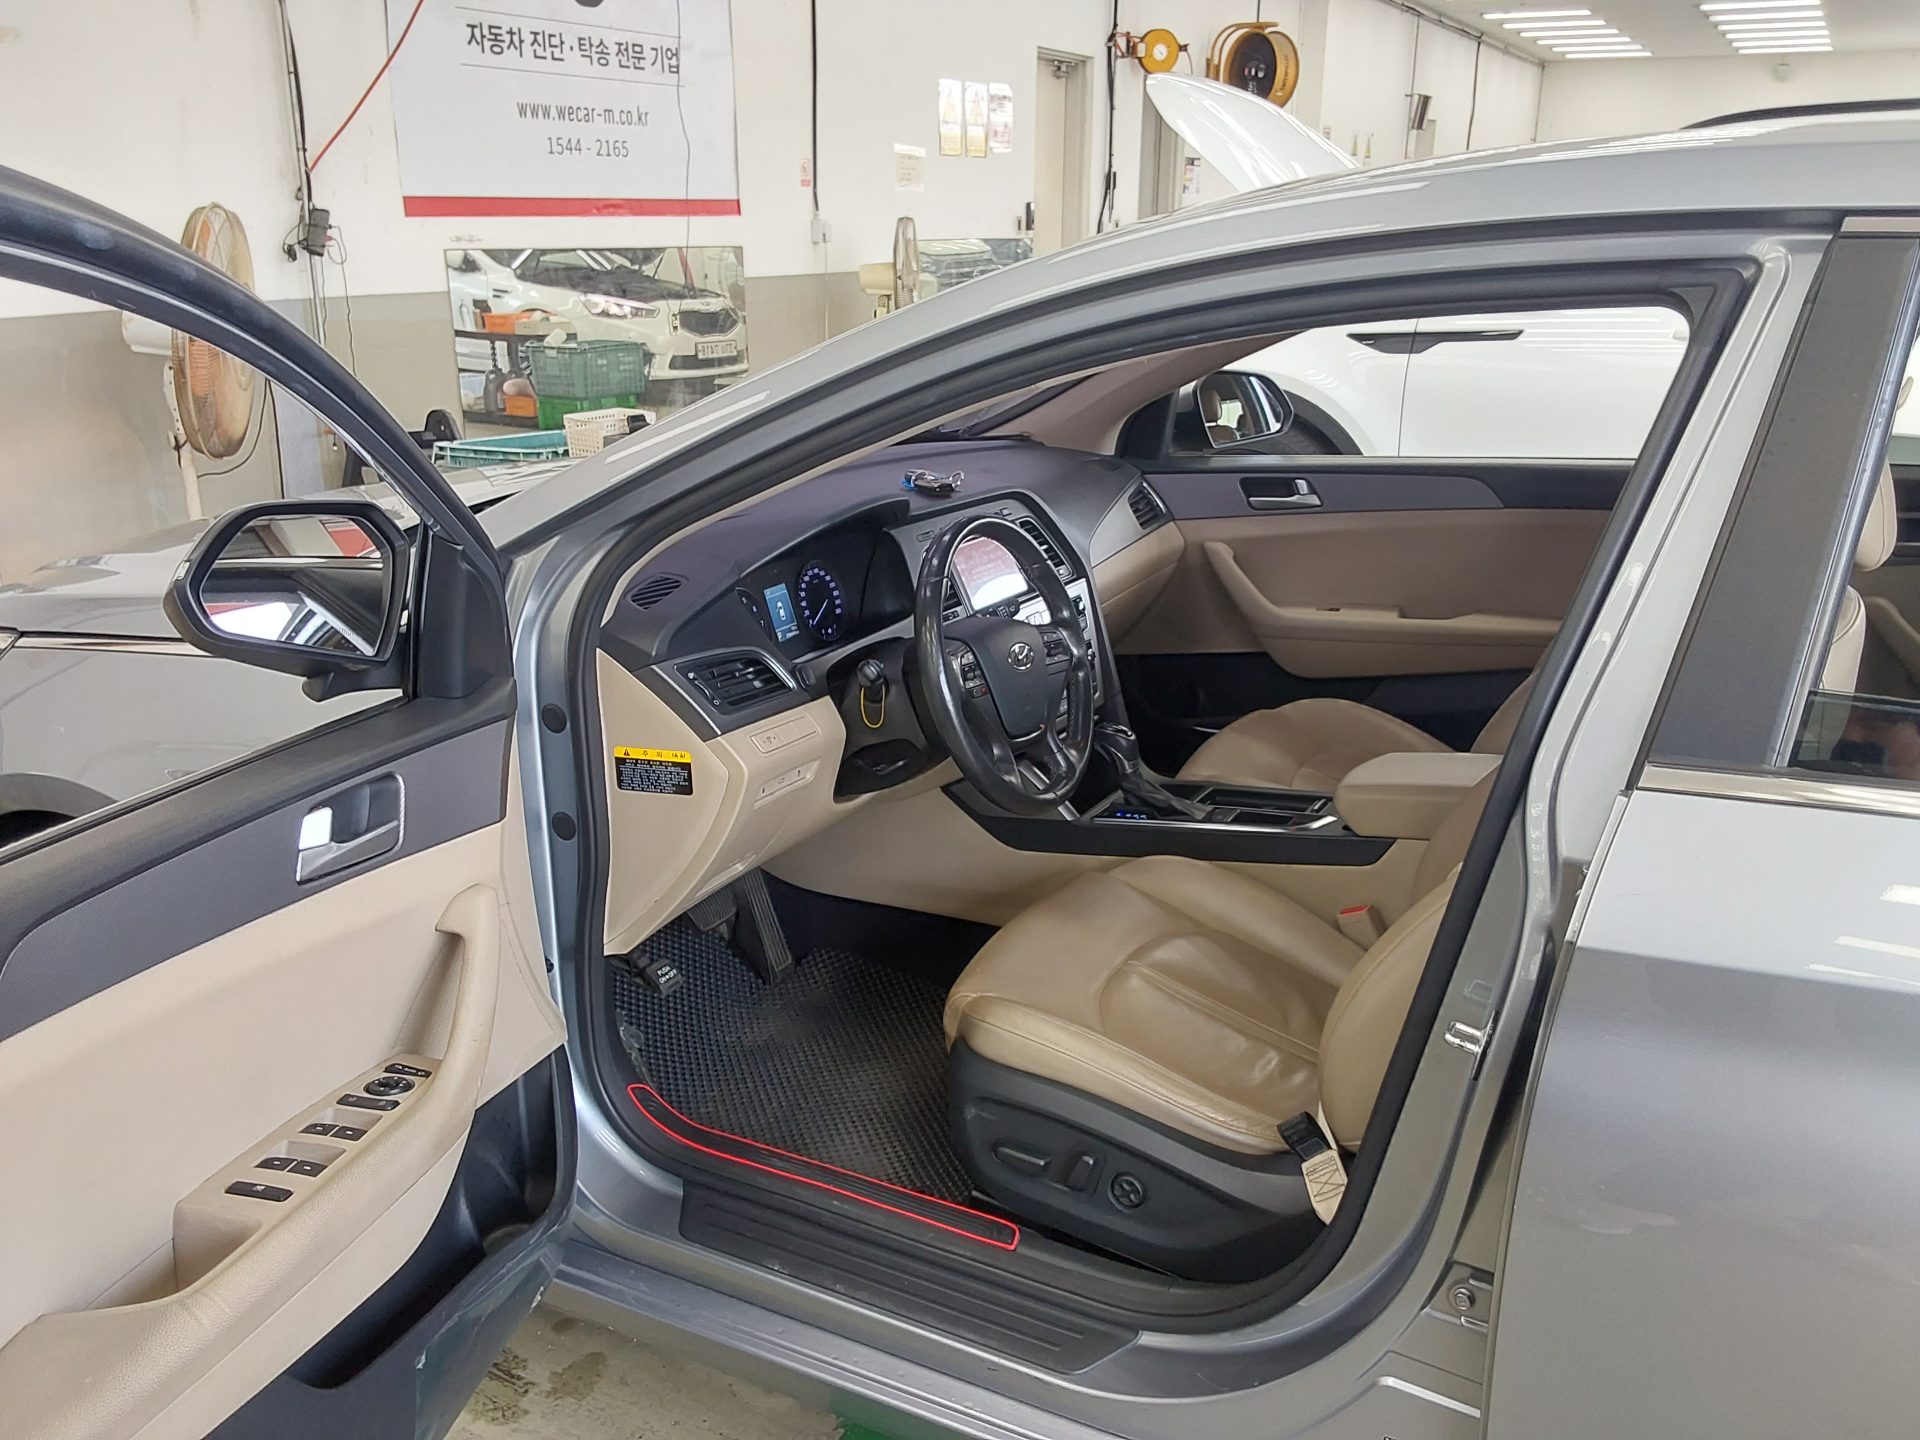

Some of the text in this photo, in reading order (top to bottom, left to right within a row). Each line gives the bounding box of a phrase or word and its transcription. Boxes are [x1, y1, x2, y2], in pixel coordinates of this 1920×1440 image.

[465, 22, 525, 58] 자동차
[614, 40, 646, 71] 전문
[650, 45, 680, 75] 기업
[516, 101, 649, 127] www.wecar-m.co.kr
[656, 965, 671, 976] PUSH
